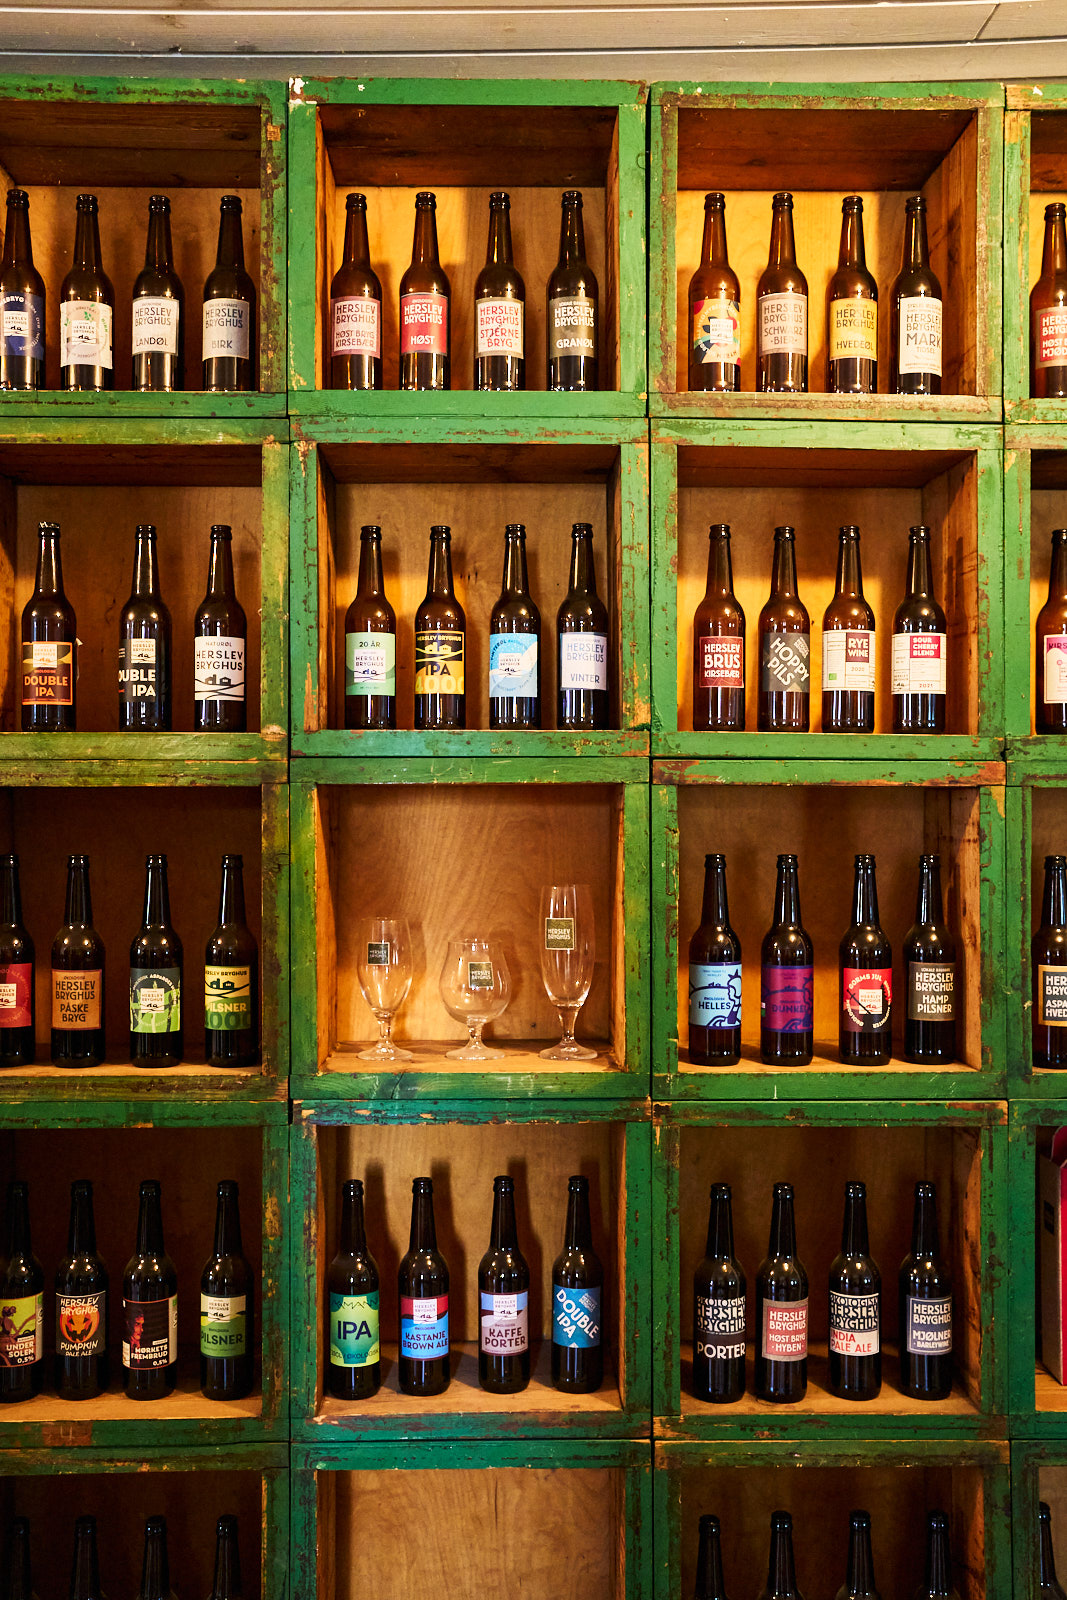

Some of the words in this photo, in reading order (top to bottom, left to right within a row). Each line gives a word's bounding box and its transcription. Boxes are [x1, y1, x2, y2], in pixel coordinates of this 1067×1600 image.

[136, 307, 172, 317] HERSLEV
[206, 308, 244, 318] HERSLEV
[336, 304, 376, 314] HERSLEV
[404, 304, 442, 314] HERSLEV
[481, 306, 519, 316] HERSLEV
[555, 306, 594, 318] HERSLEV
[764, 304, 802, 314] HERSEV
[336, 314, 376, 324] BRYGHUS
[404, 314, 442, 325] BRYGHUS
[764, 314, 802, 324] BRYGUS
[837, 309, 874, 320] HERSLEV
[136, 316, 171, 326] BRYGHUS
[206, 318, 244, 328] BRYGHUS
[481, 315, 519, 326] BRYGHUS
[555, 316, 594, 327] BRYGHUS
[837, 319, 874, 330] BRYGHUS
[336, 330, 353, 339] HØST
[136, 337, 168, 346] LANDØL
[212, 340, 232, 349] BIRK
[411, 335, 435, 345] HØST
[487, 338, 512, 348] BRYG
[556, 338, 594, 348] GRANØL
[837, 340, 874, 350] HVEDEØL
[906, 333, 941, 348] MARK
[568, 643, 604, 653] HERSLEV
[704, 644, 740, 653] HERSLEV
[848, 638, 868, 649] RYE
[197, 651, 243, 660] HERSLEV
[567, 652, 603, 662] BRYGHUS
[848, 649, 868, 657] WINE
[704, 654, 740, 668] BRUS
[770, 637, 809, 681] HOPPY
[197, 661, 243, 671] BRYGHUS
[426, 664, 450, 676] IPA
[704, 669, 740, 678] KIRSEBÆR
[767, 657, 795, 686] PILS
[25, 676, 68, 686] DOUBLE
[571, 673, 600, 683] VINTER
[35, 687, 55, 696] IPA
[133, 684, 156, 696] IPA
[916, 972, 954, 982] HERSLEV
[1046, 976, 1067, 986] HER
[56, 981, 95, 990] HERSLEV
[916, 982, 954, 992] BRYGHUS
[56, 991, 95, 1000] BRYGHUS
[923, 995, 949, 1003] HAMP
[60, 1002, 88, 1012] PÅSKE
[918, 1004, 952, 1014] PILSNER
[62, 1013, 86, 1022] BRYG
[61, 1296, 99, 1308] HERSLEV
[61, 1305, 98, 1316] BRYGHUS
[557, 1289, 599, 1339] DOUBLE
[770, 1311, 806, 1321] HERSLEV
[913, 1313, 951, 1324] BRYGHUS
[338, 1320, 372, 1340] IPA
[557, 1312, 577, 1338] IPA
[770, 1320, 806, 1330] BRYGHUS
[406, 1331, 446, 1341] KASTANJE
[489, 1327, 522, 1338] KAFFE
[485, 1336, 525, 1348] PORTER
[769, 1333, 790, 1343] HØST
[791, 1333, 806, 1342] BRYG
[6, 1341, 34, 1351] UNDER
[61, 1340, 98, 1351] PUMPKIN
[402, 1340, 434, 1350] BROWN
[437, 1338, 448, 1348] ALE
[775, 1343, 802, 1352] HYBEN
[831, 1339, 851, 1352] PALE
[855, 1343, 872, 1352] ALE
[8, 1348, 34, 1358] SOLEN
[697, 1342, 745, 1359] PORTER
